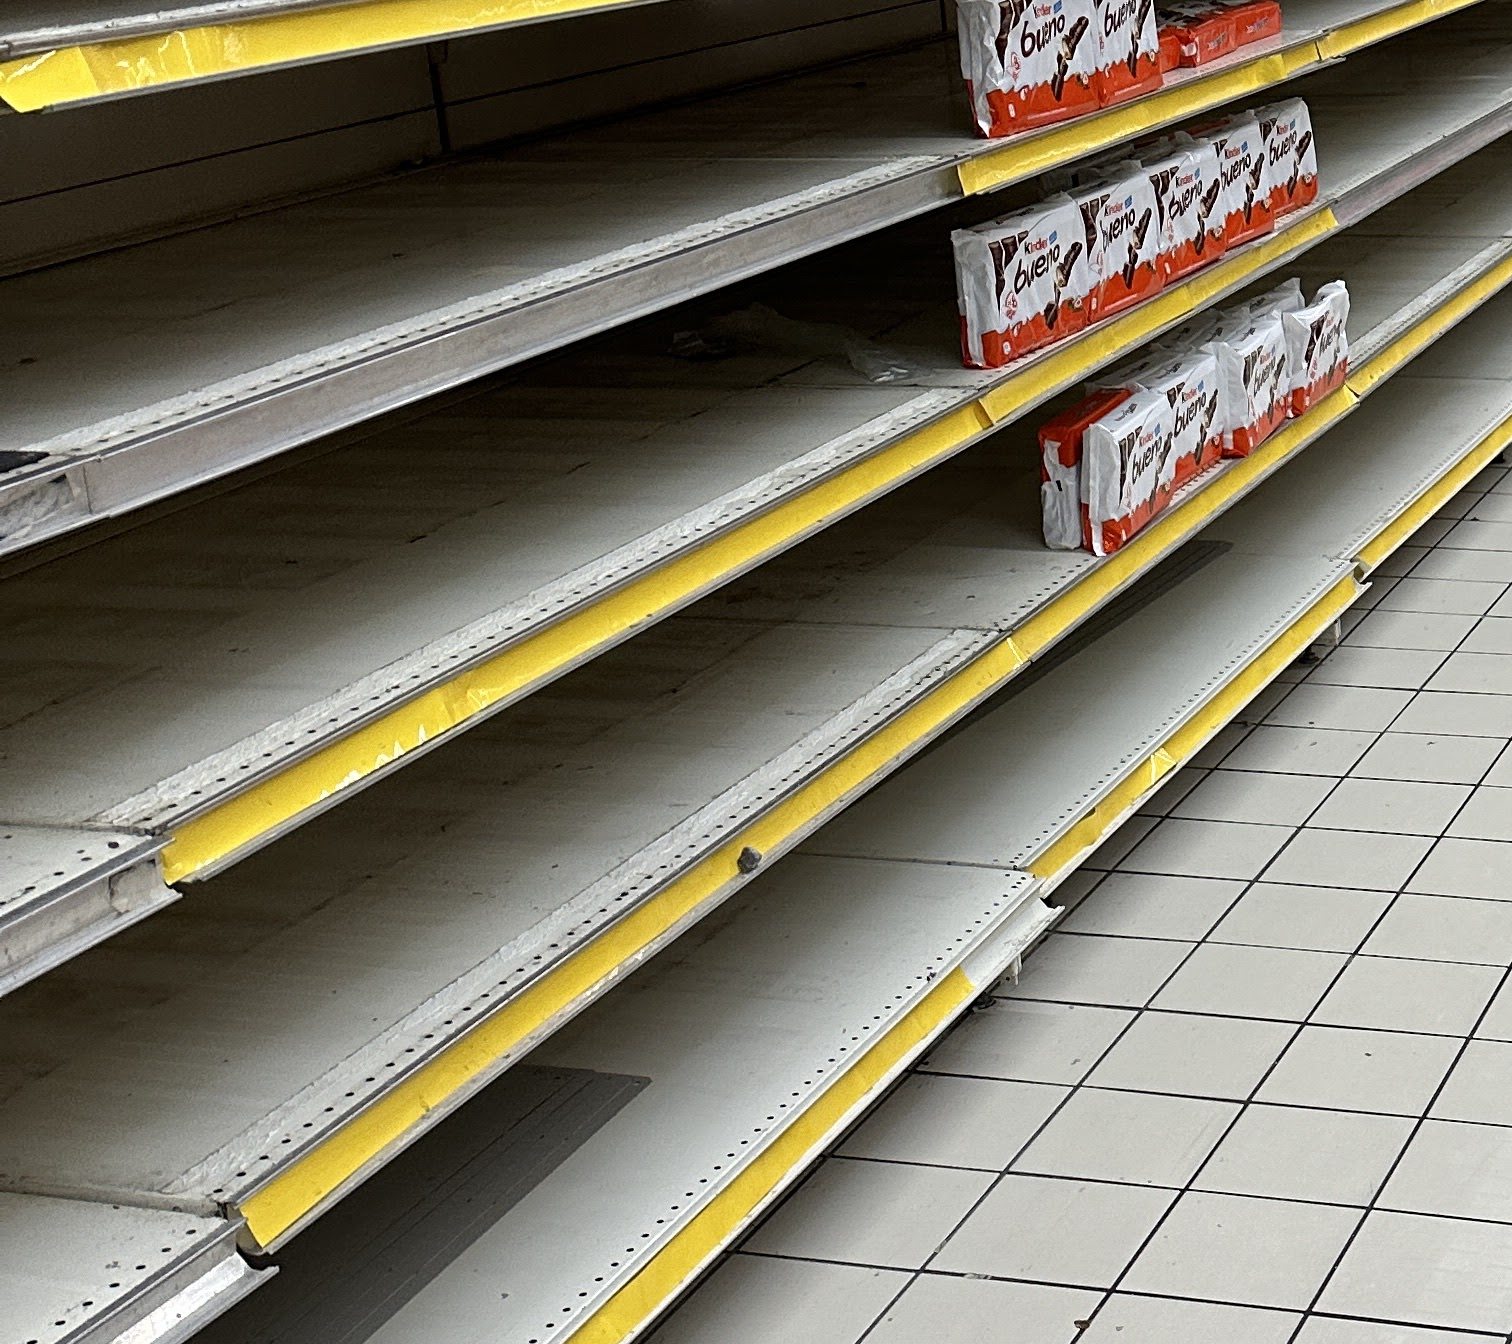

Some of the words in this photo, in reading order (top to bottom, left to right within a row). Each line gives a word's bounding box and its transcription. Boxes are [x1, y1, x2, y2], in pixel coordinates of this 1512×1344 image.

[1020, 14, 1066, 58] bueno
[1219, 153, 1252, 192] bueno
[1014, 244, 1060, 295] bueno
[1173, 391, 1207, 438] bueno
